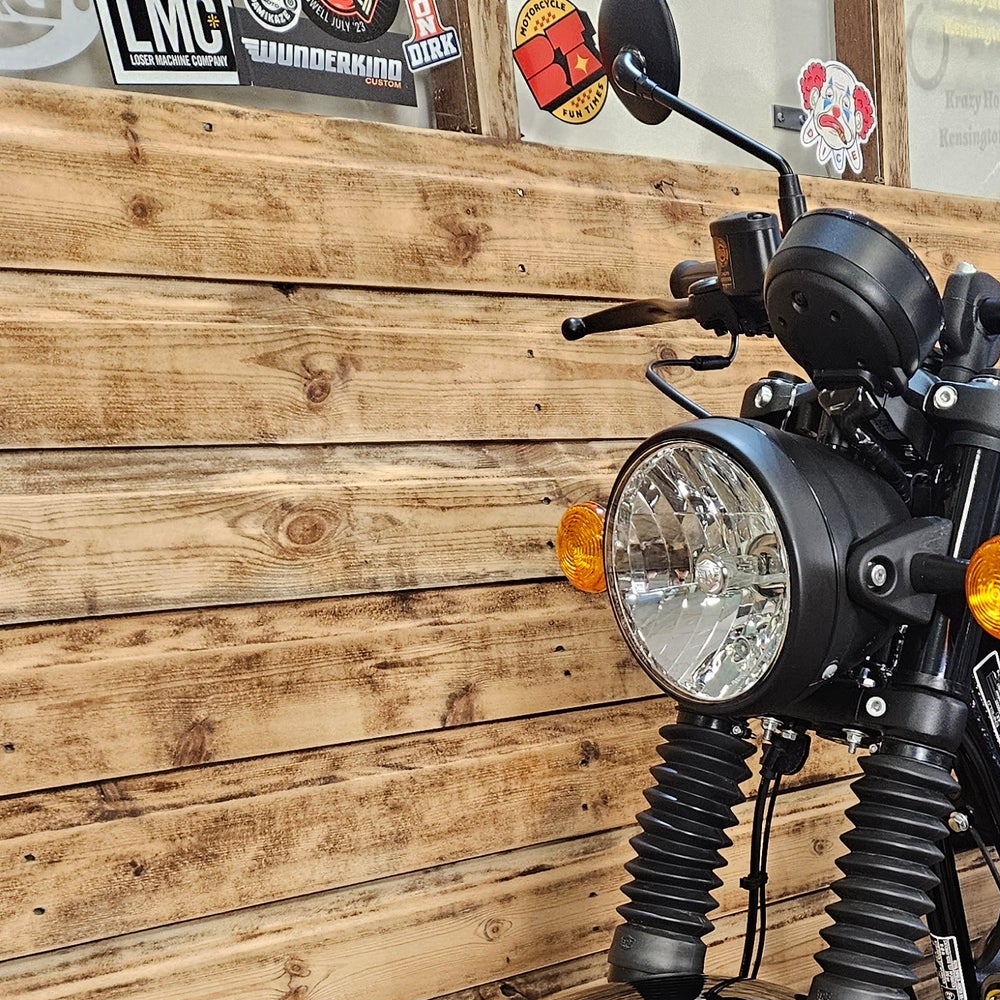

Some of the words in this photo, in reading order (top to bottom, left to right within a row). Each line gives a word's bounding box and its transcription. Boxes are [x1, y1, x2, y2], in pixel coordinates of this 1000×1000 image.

[115, 0, 224, 54] LMC
[250, 0, 291, 24] AMIKAZE
[331, 17, 350, 33] JULY
[520, 0, 566, 37] MOTORCYCLE
[129, 54, 155, 66] LOSER
[155, 54, 191, 67] MACHINE
[191, 55, 228, 67] COMPANY
[241, 37, 403, 82] WUNDERKIND
[407, 32, 458, 67] DIRK
[365, 77, 402, 89] CUSTOM
[562, 108, 583, 119] FUN
[585, 83, 604, 115] TIMES
